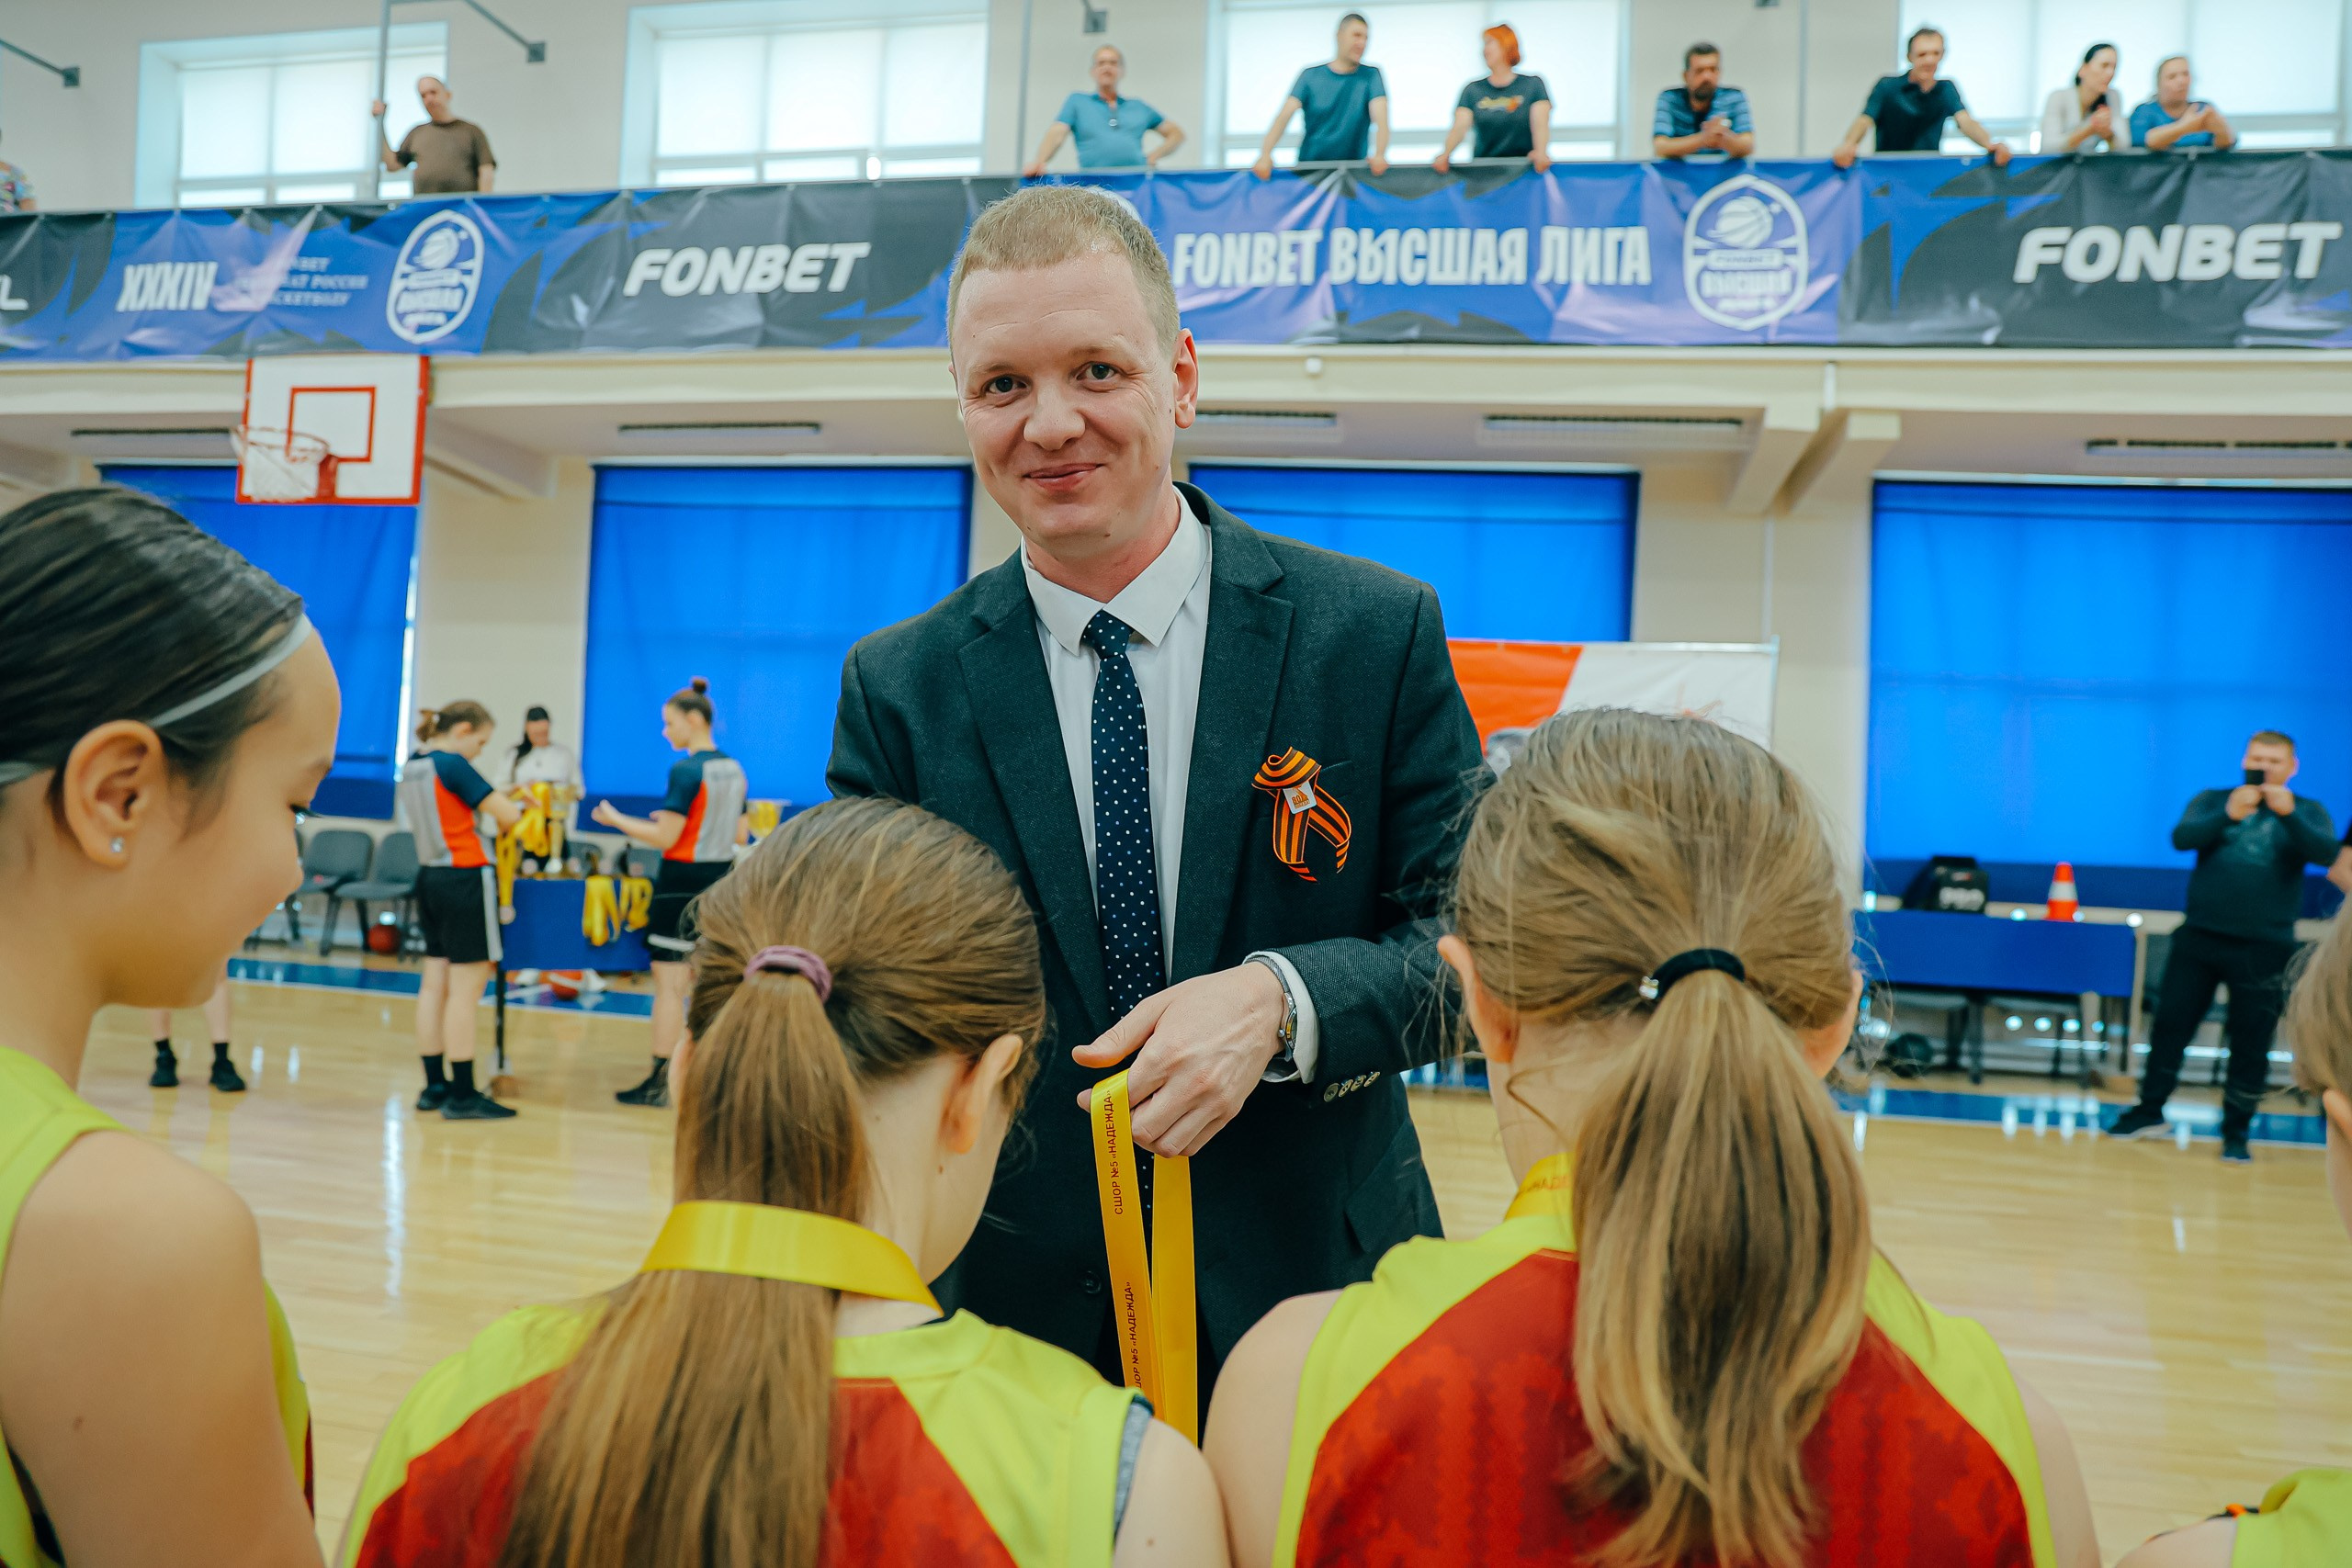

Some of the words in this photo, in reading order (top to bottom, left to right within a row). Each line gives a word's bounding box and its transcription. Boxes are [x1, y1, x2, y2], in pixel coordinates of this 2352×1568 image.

[623, 243, 871, 297] FONBET
[1173, 229, 1323, 288] FONBET
[1329, 227, 1529, 286] ВЫСШАЯ
[1536, 226, 1652, 286] ЛИГА
[2013, 221, 2343, 283] FONBET
[115, 261, 219, 311] XXXIV
[1103, 1090, 1117, 1159] «НАДЕЖДА»
[1110, 1161, 1120, 1178] №5
[1112, 1181, 1123, 1215] СШОР
[1124, 1281, 1137, 1347] «НАДЕЖДА»
[1130, 1348, 1139, 1364] №5
[1133, 1367, 1142, 1389] ШОР
